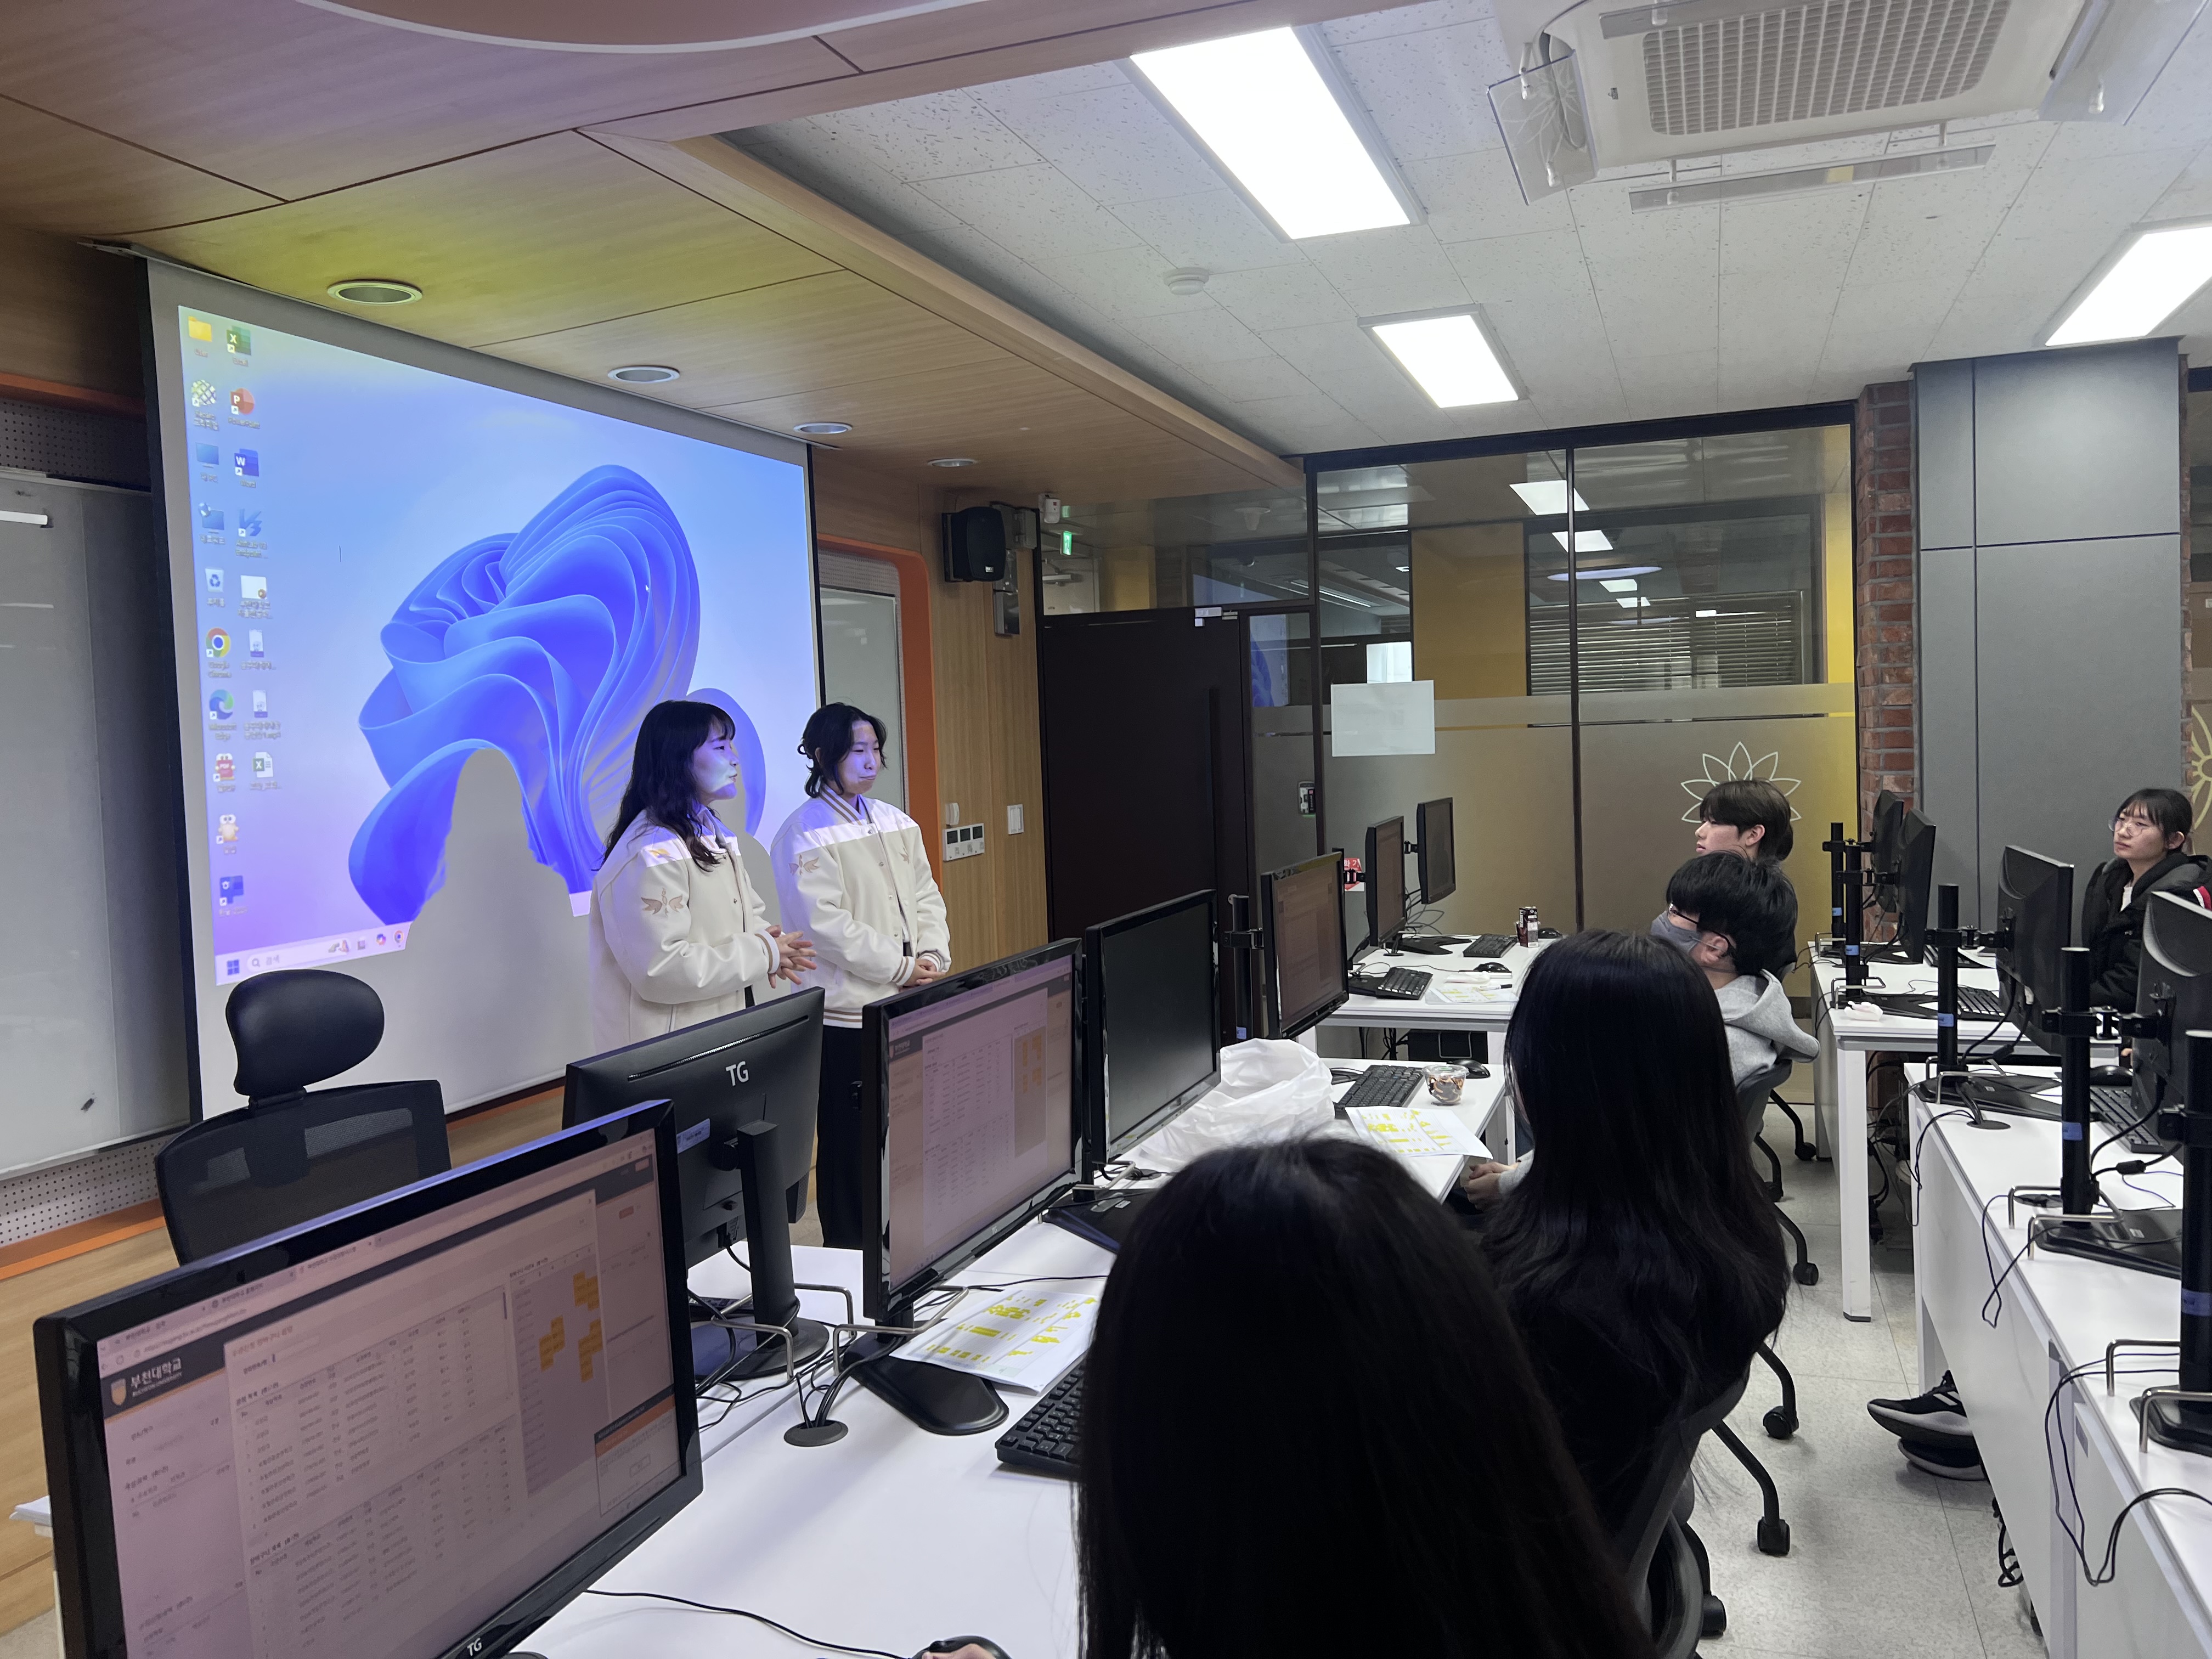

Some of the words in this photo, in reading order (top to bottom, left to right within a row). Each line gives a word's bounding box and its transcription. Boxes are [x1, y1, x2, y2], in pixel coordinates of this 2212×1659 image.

[236, 456, 245, 466] W
[725, 1061, 749, 1086] TG
[131, 1357, 182, 1389] 부천대학교
[467, 1637, 482, 1656] TG
